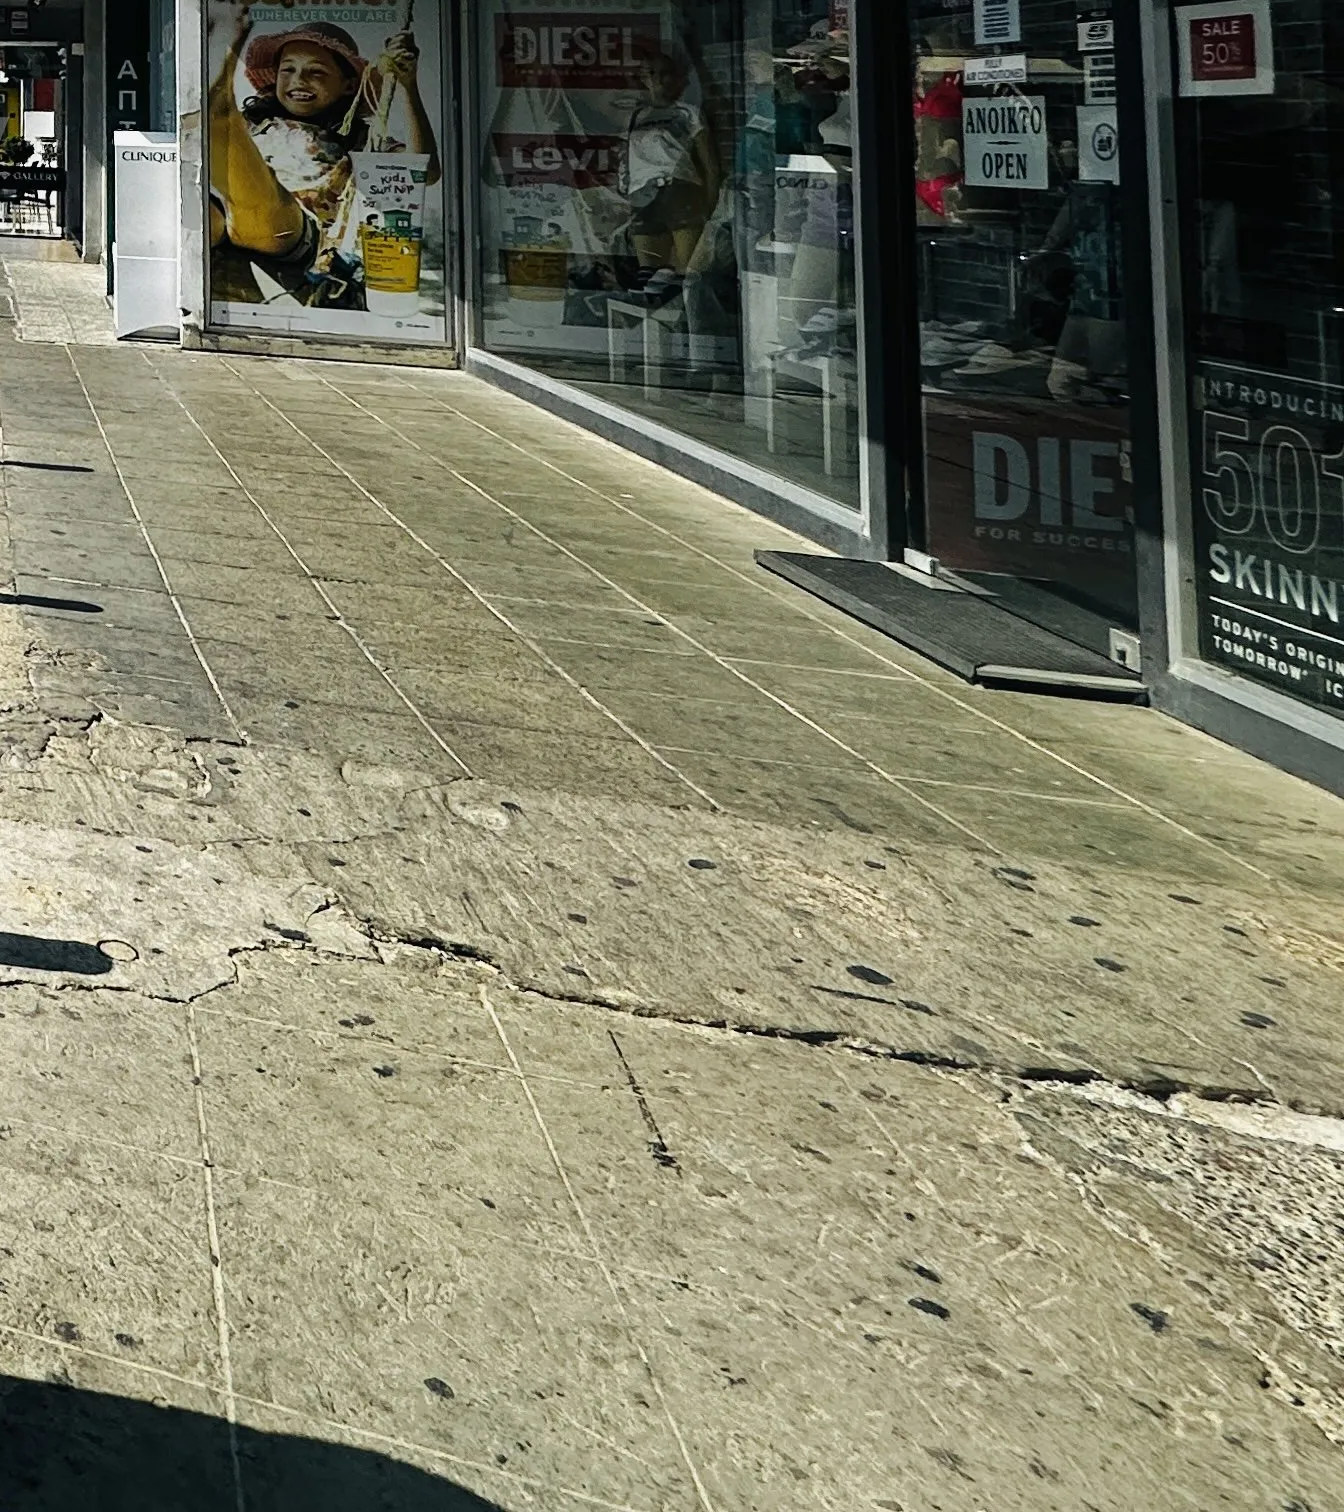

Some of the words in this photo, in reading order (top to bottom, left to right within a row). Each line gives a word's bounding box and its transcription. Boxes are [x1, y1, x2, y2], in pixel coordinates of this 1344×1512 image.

[252, 9, 329, 22] WHEREVER
[332, 9, 361, 21] YOU
[1202, 20, 1241, 36] SALE
[512, 25, 642, 67] DIESEL
[13, 172, 58, 181] GALLERY
[981, 152, 1028, 180] OPEN
[972, 430, 1136, 533] DIE
[974, 525, 1022, 543] FOR
[1208, 542, 1344, 625] SKINN
[1211, 613, 1279, 652] TODAY'S
